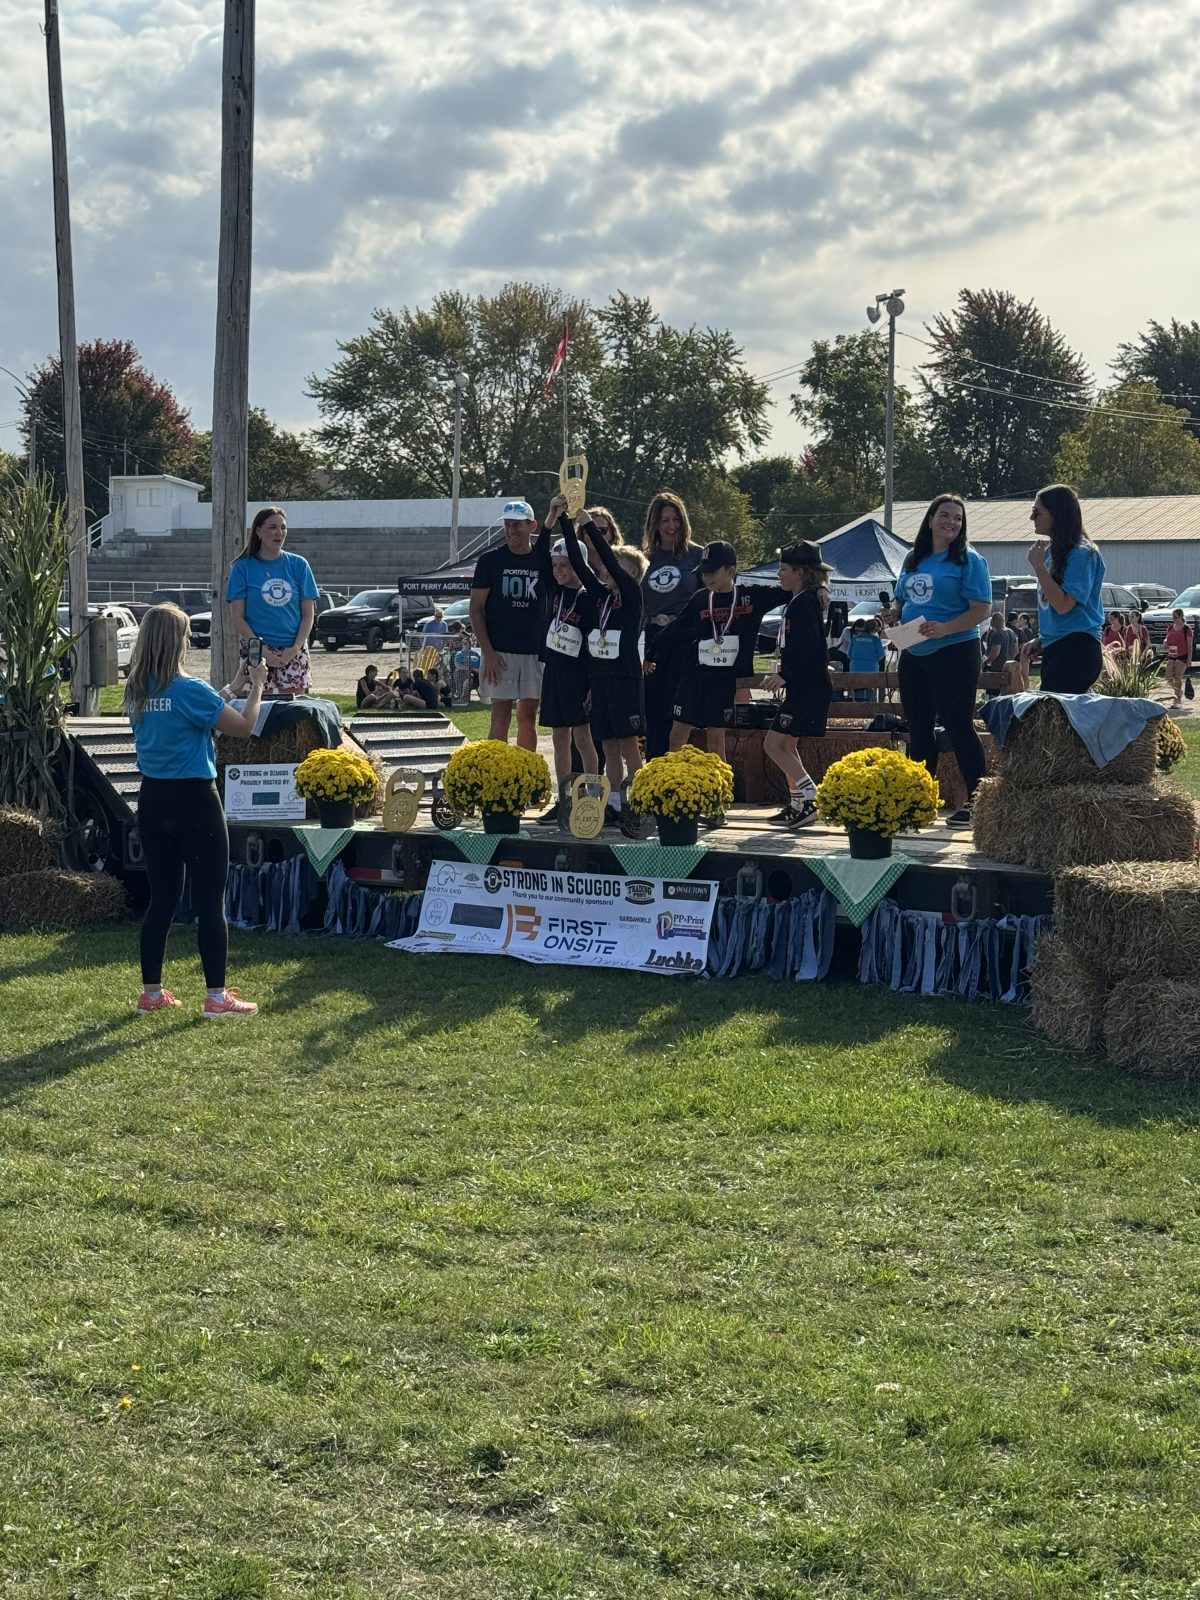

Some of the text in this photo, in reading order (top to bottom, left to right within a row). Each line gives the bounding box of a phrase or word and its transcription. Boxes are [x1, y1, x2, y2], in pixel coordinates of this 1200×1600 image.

[502, 576, 539, 600] 10K
[740, 595, 751, 606] 16
[673, 704, 682, 716] 16
[427, 886, 448, 894] NORTH
[502, 869, 621, 898] STRONG IN SCUGOG
[512, 890, 527, 899] Thank
[554, 896, 585, 905] community
[585, 898, 614, 906] sponsors!
[548, 917, 608, 936] FIRST
[543, 935, 618, 955] ONSITE
[644, 948, 703, 971] Luchka
